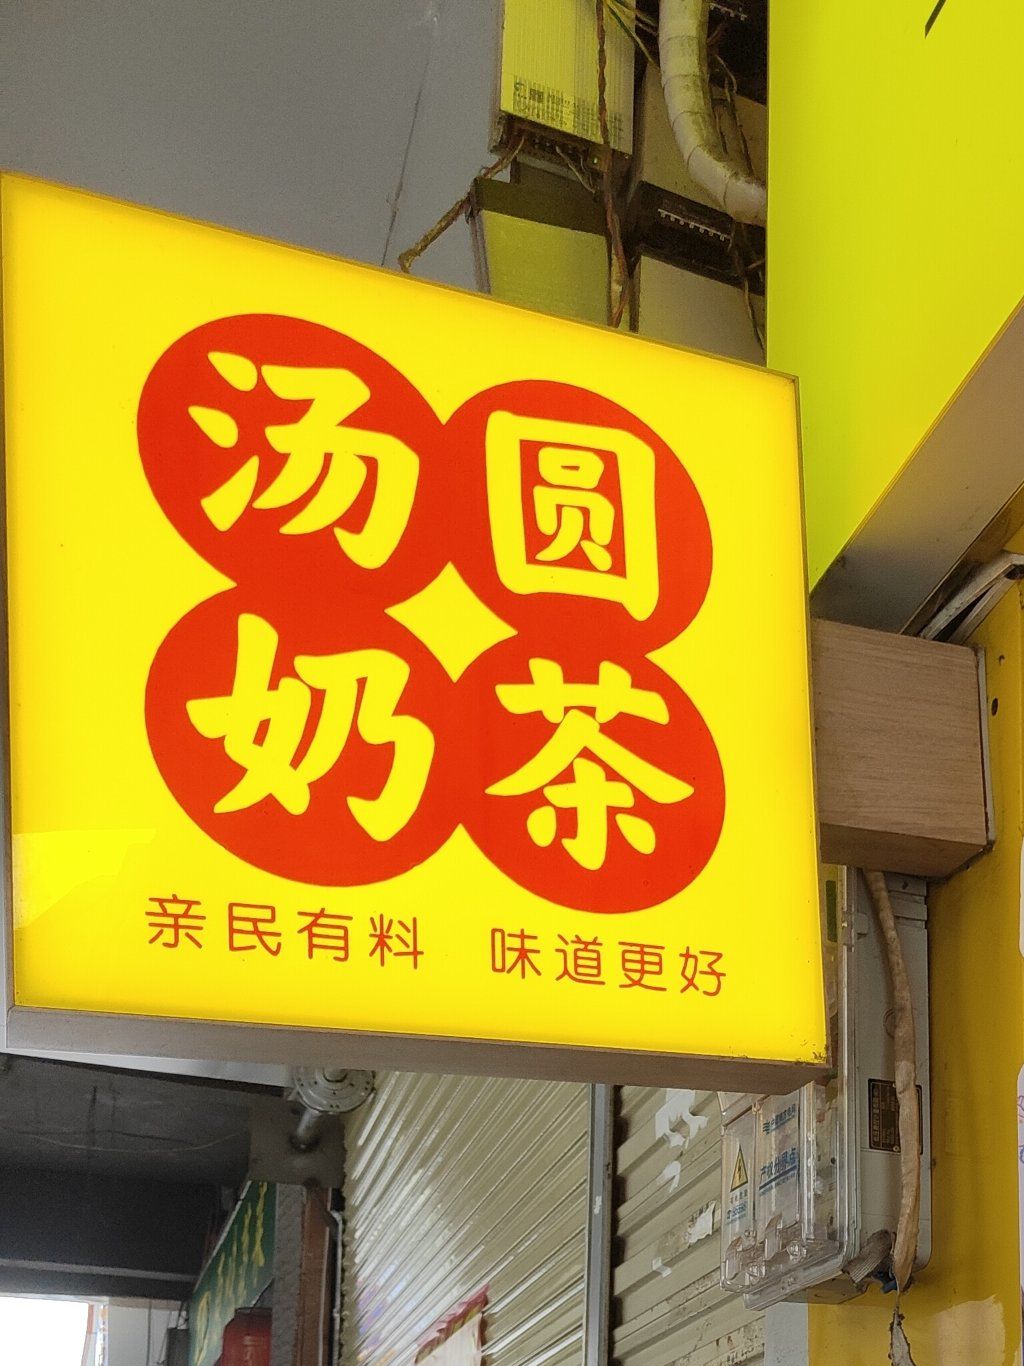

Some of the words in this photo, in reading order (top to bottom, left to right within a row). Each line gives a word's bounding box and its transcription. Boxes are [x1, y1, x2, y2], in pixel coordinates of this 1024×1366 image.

[189, 351, 657, 621] 汤圆
[186, 613, 694, 870] 奶茶
[146, 894, 425, 970] 亲民有料
[490, 927, 728, 996] 味道更好
